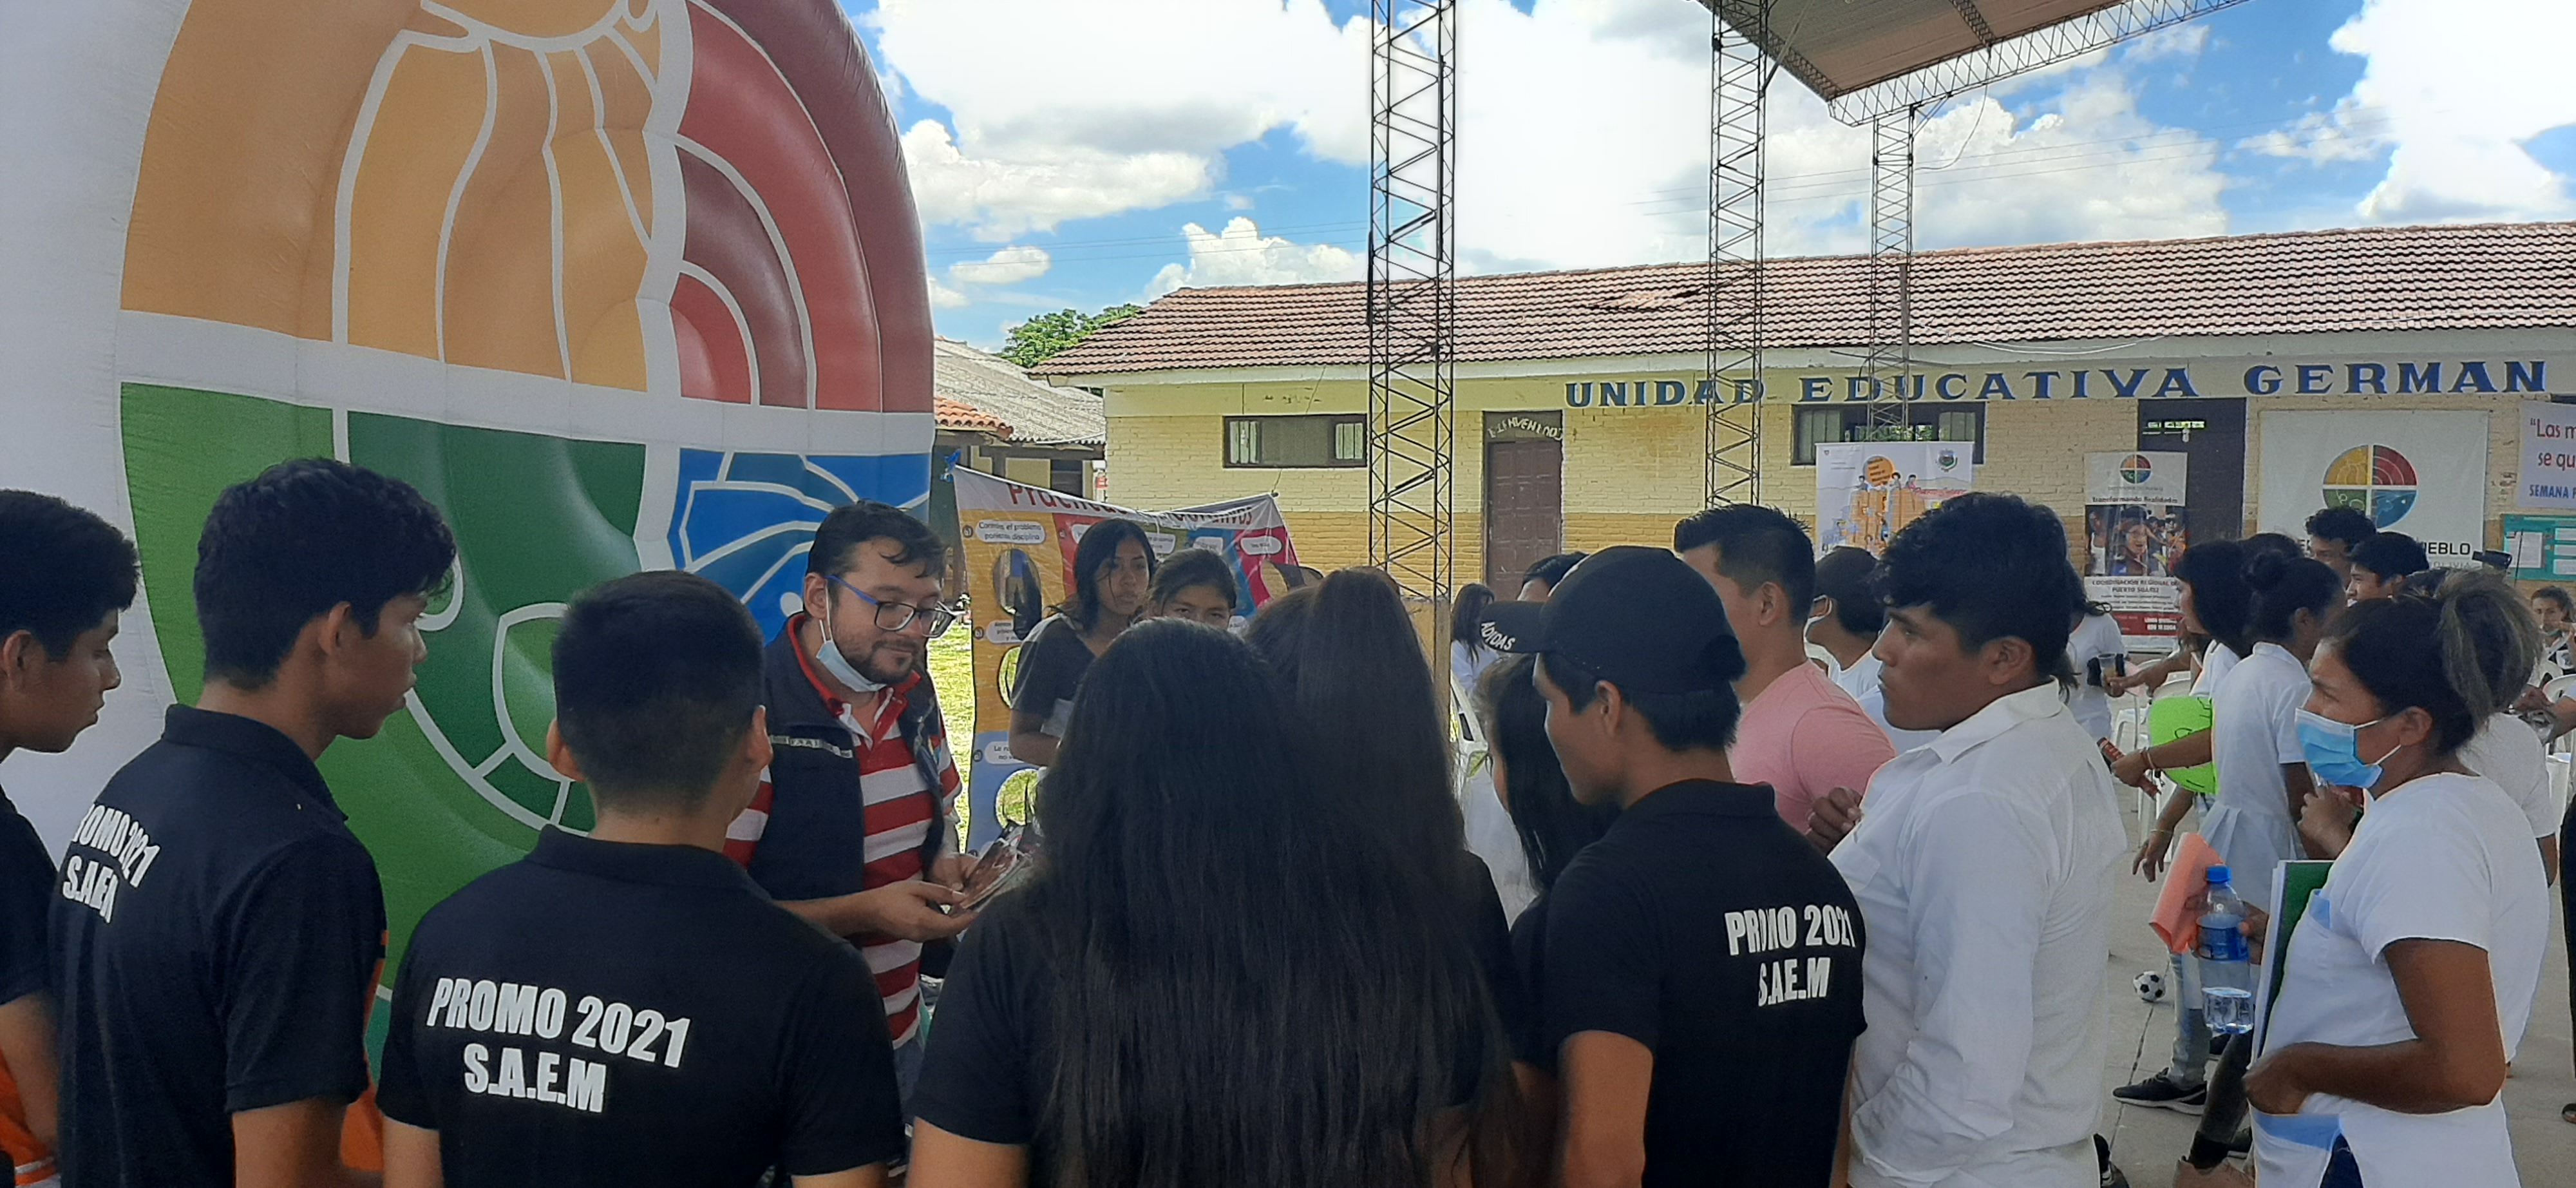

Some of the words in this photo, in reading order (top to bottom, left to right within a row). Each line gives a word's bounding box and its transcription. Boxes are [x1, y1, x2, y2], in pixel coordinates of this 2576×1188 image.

[1565, 379, 1764, 407] UNIDAD
[1798, 369, 2199, 402] EDUCATIVA
[2244, 361, 2546, 395] GERMAN
[2538, 452, 2552, 466] se
[2529, 484, 2569, 499] SEMANA
[1481, 621, 1515, 651] ADIDAS
[1724, 906, 1797, 956] PROMO
[1804, 904, 1856, 948] 2021
[426, 977, 567, 1039] PROMO
[571, 995, 691, 1068] 2021
[463, 1043, 607, 1113] S.A.E.M
